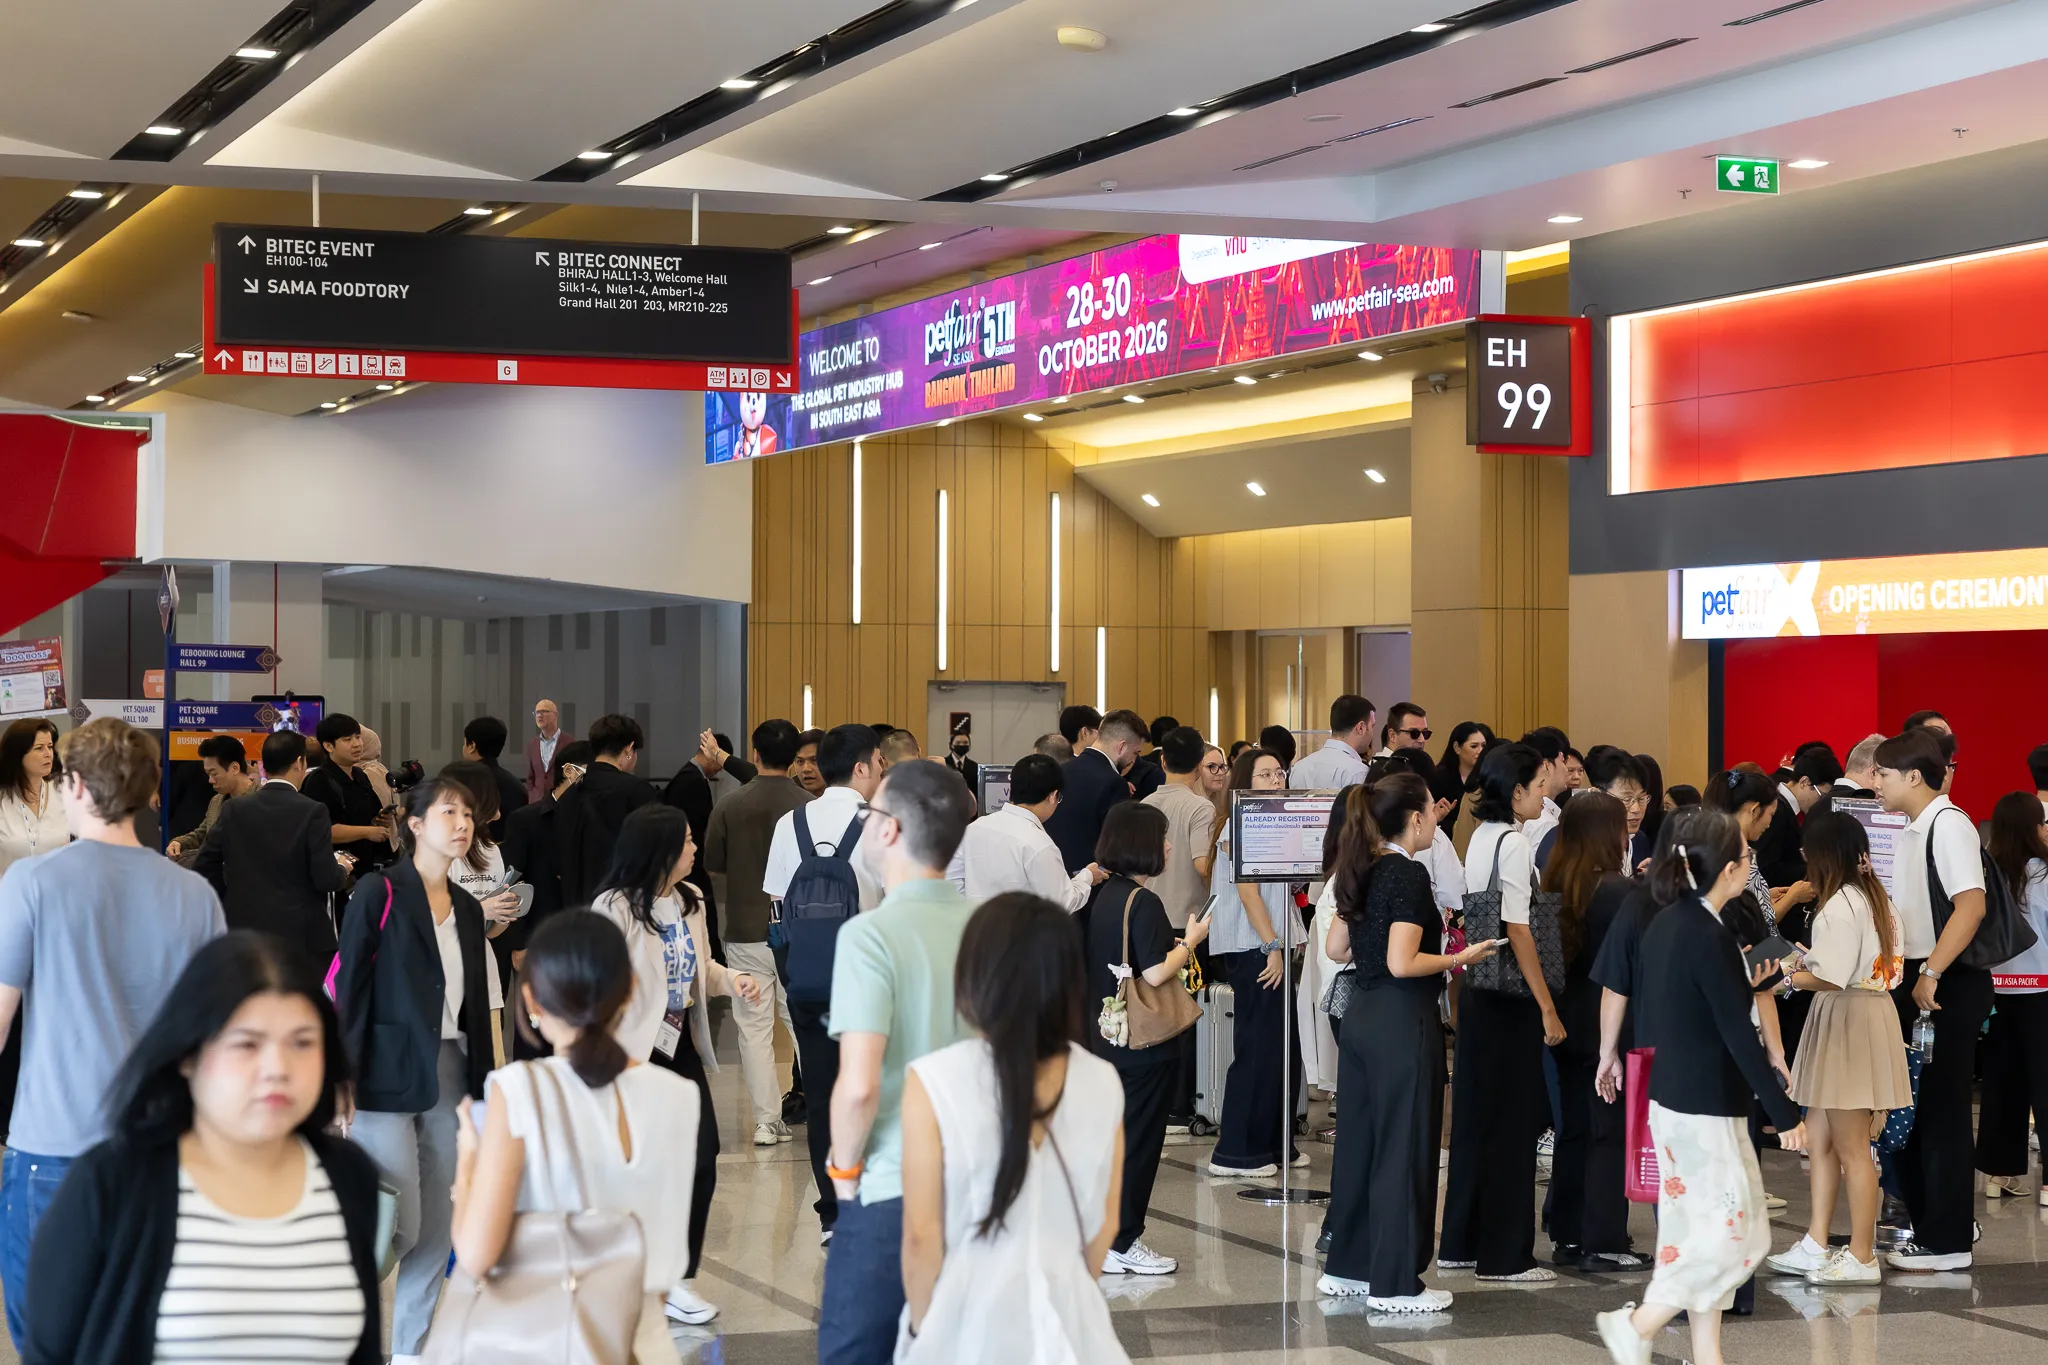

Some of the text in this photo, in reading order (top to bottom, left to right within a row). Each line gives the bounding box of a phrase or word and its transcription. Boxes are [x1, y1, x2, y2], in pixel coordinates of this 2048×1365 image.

[266, 238, 375, 258] BITEC EVENT
[266, 254, 328, 268] EH100-104
[558, 252, 682, 271] BITEC CONNECT
[558, 268, 728, 285] BHIRAJ HALL1-3, Welcome Hall
[267, 279, 409, 299] SAMA FOODTORY
[558, 281, 601, 295] Silk1-4,
[651, 285, 705, 297] Amber1-4
[559, 296, 728, 313] Grand Hall 201 203, MR210-225
[1066, 272, 1131, 329] 28-30
[1311, 275, 1454, 321] www.petfair-sea.com
[983, 300, 1016, 359] 5TH
[1038, 318, 1168, 376] OCTOBER 2026
[1487, 337, 1527, 368] EH
[809, 336, 880, 377] WELCOME TO
[362, 368, 382, 376] COACH
[503, 366, 511, 376] G
[709, 370, 725, 378] ATM
[969, 363, 1016, 398] THAILAND
[791, 370, 904, 412] THE GLOBAL PET INDUSTRY HUB
[810, 399, 882, 430] IN SOUTH EAST ASIA
[1497, 382, 1552, 430] 99
[1828, 575, 2048, 614] OPENING CEREMON
[180, 648, 245, 659] REBOOKING LOUNGE
[180, 658, 207, 667] HALL 99
[122, 705, 156, 714] VET SQUARE
[179, 706, 218, 715] PET SQUARE
[122, 715, 149, 723] HALL 100
[179, 716, 205, 724] HALL 99
[177, 736, 212, 745] BUSINE
[2004, 977, 2018, 986] ASIA
[2018, 977, 2039, 986] PACIFIC
